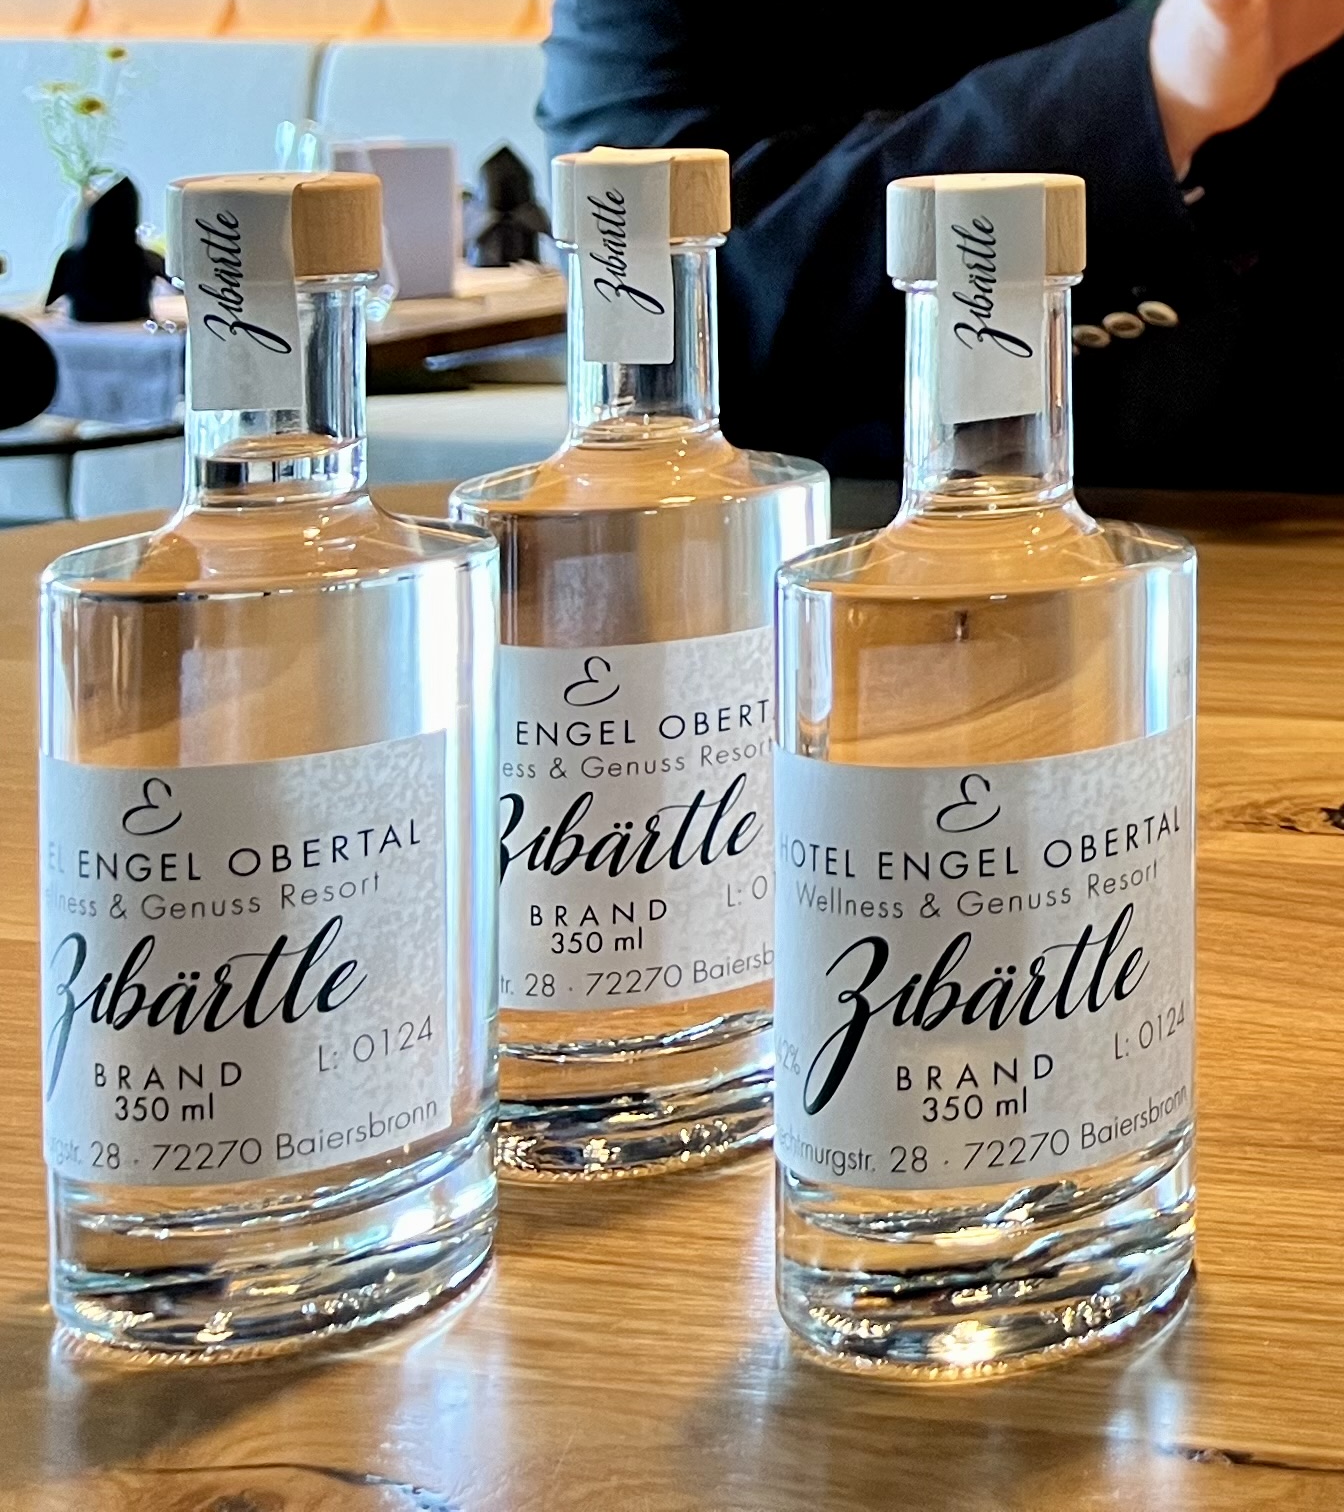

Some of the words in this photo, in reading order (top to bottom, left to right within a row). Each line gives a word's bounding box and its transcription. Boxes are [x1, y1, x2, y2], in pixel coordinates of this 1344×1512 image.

[516, 719, 636, 746] ENGEL
[658, 699, 769, 739] OBERT
[549, 757, 567, 779] &
[581, 755, 685, 778] Genuss
[78, 850, 201, 882] ENGEL
[228, 819, 421, 877] OBERTAL
[780, 833, 856, 878] HOTEL
[878, 846, 1019, 881] ENGEL
[1043, 805, 1180, 868] OBERTAL
[109, 893, 128, 920] &
[141, 893, 261, 920] Genuss
[281, 872, 381, 910] Resort
[530, 899, 667, 927] BRAND
[796, 879, 904, 919] Wellness
[920, 892, 941, 919] &
[957, 888, 1072, 918] Genuss
[1087, 859, 1158, 900] Resort
[551, 931, 602, 954] 350
[615, 926, 643, 951] ml
[525, 973, 556, 997] 28
[586, 964, 682, 996] 72270
[693, 943, 774, 984] Baiersb
[803, 902, 1150, 1116] Zibärtle
[1114, 1032, 1130, 1061] L:
[1139, 1000, 1185, 1050] 0124
[318, 1044, 339, 1072] L:
[353, 1015, 433, 1063] 0124
[94, 1062, 243, 1091] BRAND
[897, 1053, 1054, 1091] BRAND
[115, 1096, 169, 1122] 350
[181, 1092, 214, 1121] ml
[890, 1145, 928, 1173] 28
[963, 1128, 1070, 1171] 72270
[1081, 1085, 1188, 1150] Baiersbronn
[922, 1094, 983, 1123] 350
[996, 1086, 1028, 1119] ml
[90, 1140, 121, 1170] 28
[152, 1137, 262, 1171] 72270
[276, 1100, 438, 1162] Baiersbronn
